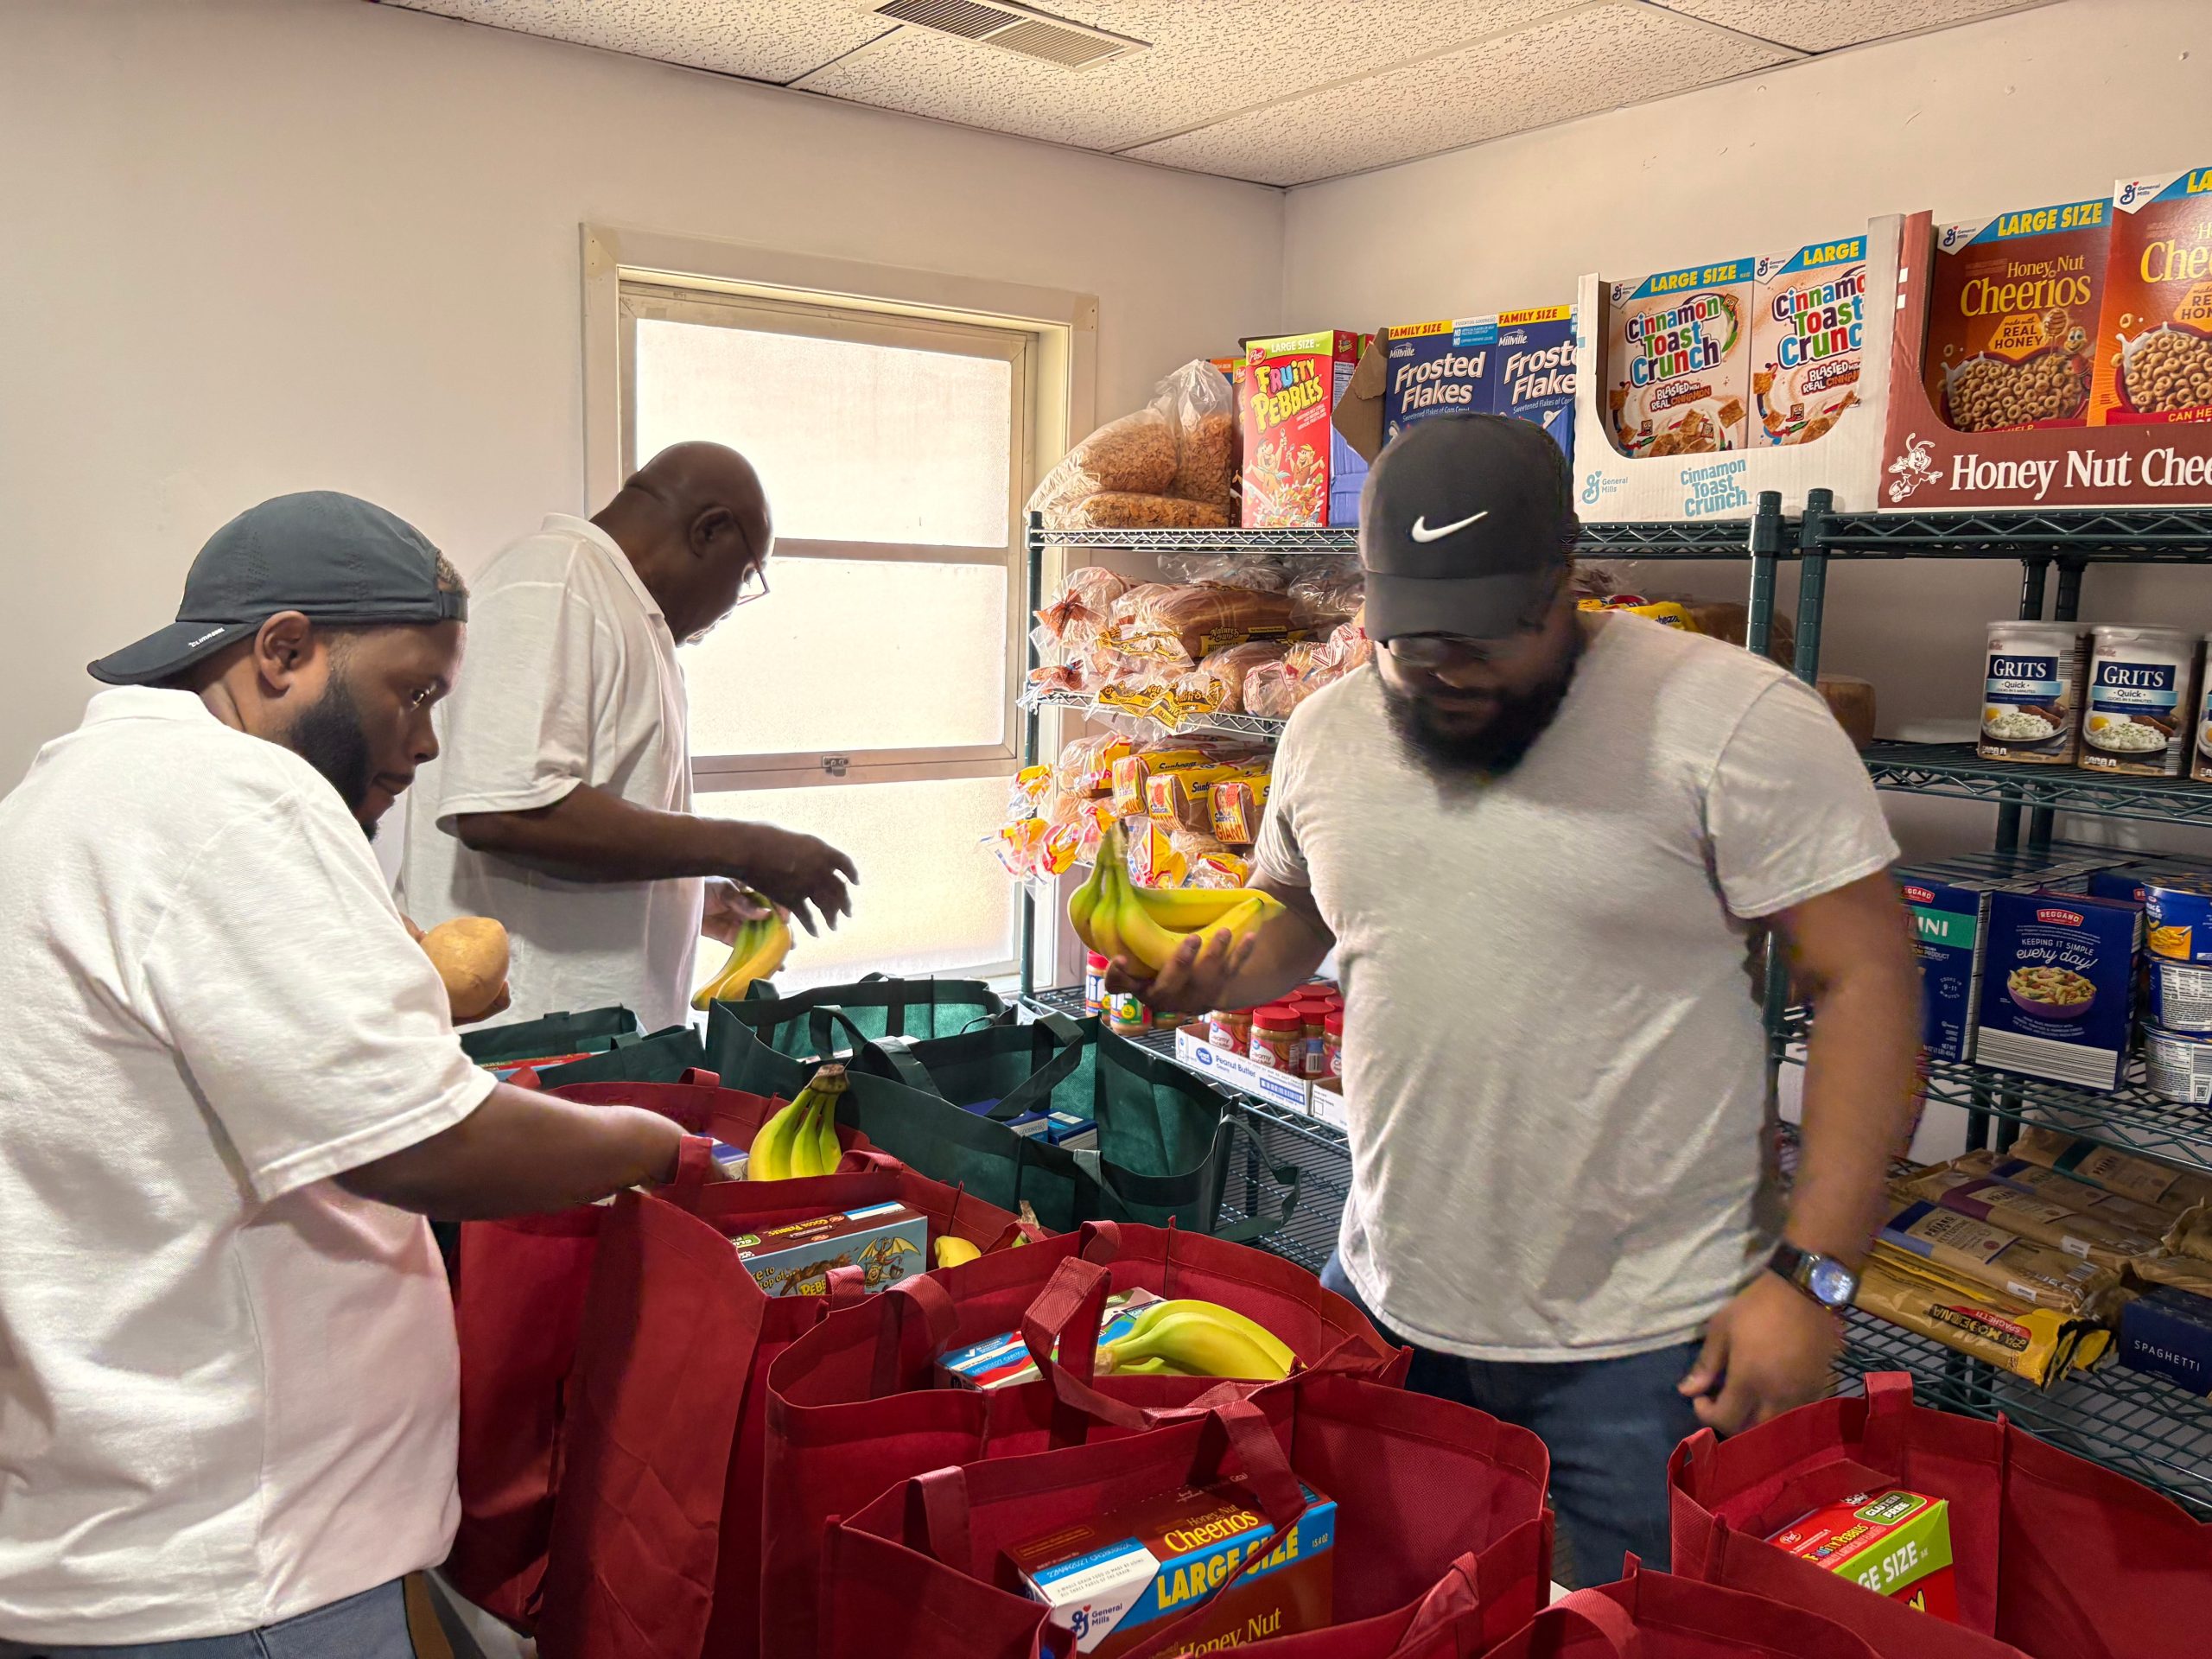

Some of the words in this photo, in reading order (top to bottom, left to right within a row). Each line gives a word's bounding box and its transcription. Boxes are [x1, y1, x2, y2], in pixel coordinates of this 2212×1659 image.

[1998, 209, 2058, 237] LARGE
[2061, 202, 2103, 228] SIZE
[1803, 241, 1860, 265] LARGE
[2007, 261, 2053, 278] Honey
[2057, 255, 2085, 272] Nut
[1650, 271, 1698, 292] LARGE
[1703, 264, 1737, 284] SIZE
[1961, 275, 2091, 317] Cheerios
[1499, 311, 1534, 325] FAMILY
[1535, 308, 1558, 321] SIZE
[1629, 297, 1719, 340] Cinnamon
[1794, 295, 1864, 337] Toast
[1389, 325, 1424, 339] FAMILY
[1425, 323, 1442, 335] SIZE
[1498, 334, 1528, 347] Millville
[1643, 321, 1702, 359] Toast
[2004, 327, 2037, 338] REAL
[1271, 341, 1296, 353] LARGE
[1298, 339, 1315, 350] SIZE
[1389, 346, 1416, 360] Millville
[1994, 336, 2044, 349] HONEY
[1249, 349, 1263, 363] Post
[1633, 336, 1719, 385] Crunch
[1394, 351, 1487, 395] Frosted
[1809, 361, 1848, 382] BLASTED
[1401, 380, 1473, 414] Flakes
[1656, 383, 1689, 400] BLASTED
[1802, 380, 1826, 394] REAL
[1250, 376, 1324, 434] PEBBLES
[1513, 401, 1539, 414] Sweetened
[1651, 399, 1671, 411] REAL
[2168, 413, 2192, 423] CAN
[1602, 477, 1629, 486] General
[1681, 459, 1746, 486] Cinnamon
[1949, 454, 2059, 501] Honey
[2064, 450, 2133, 487] Nut
[1693, 476, 1734, 499] Toast
[1685, 486, 1748, 518] Crunch
[1993, 658, 2047, 678] GRITS
[2103, 665, 2164, 688] GRITS
[2117, 690, 2142, 698] Quick
[1216, 823, 1246, 842] GIANT
[2040, 911, 2080, 922] REGGANO
[2021, 938, 2054, 947] KEEPING
[2066, 942, 2094, 957] SIMPLE
[2016, 948, 2057, 964] every
[2059, 950, 2099, 971] day!
[1216, 1055, 1237, 1071] Peanut
[1237, 1064, 1256, 1078] Butter
[1976, 1311, 2023, 1333] SPAGHETTI
[2134, 1339, 2200, 1372] SPAGHETTI
[1186, 1511, 1219, 1527] Honey
[1219, 1503, 1240, 1516] Nut
[1865, 1495, 1902, 1517] GLUTEN
[1882, 1501, 1911, 1519] FREE
[1164, 1510, 1259, 1553] Cheerios
[1883, 1541, 1918, 1583] SIZE
[1157, 1548, 1240, 1610] LARGE
[1092, 1604, 1122, 1618] General
[1092, 1617, 1109, 1626] Mills
[1249, 1607, 1281, 1642] Nut
